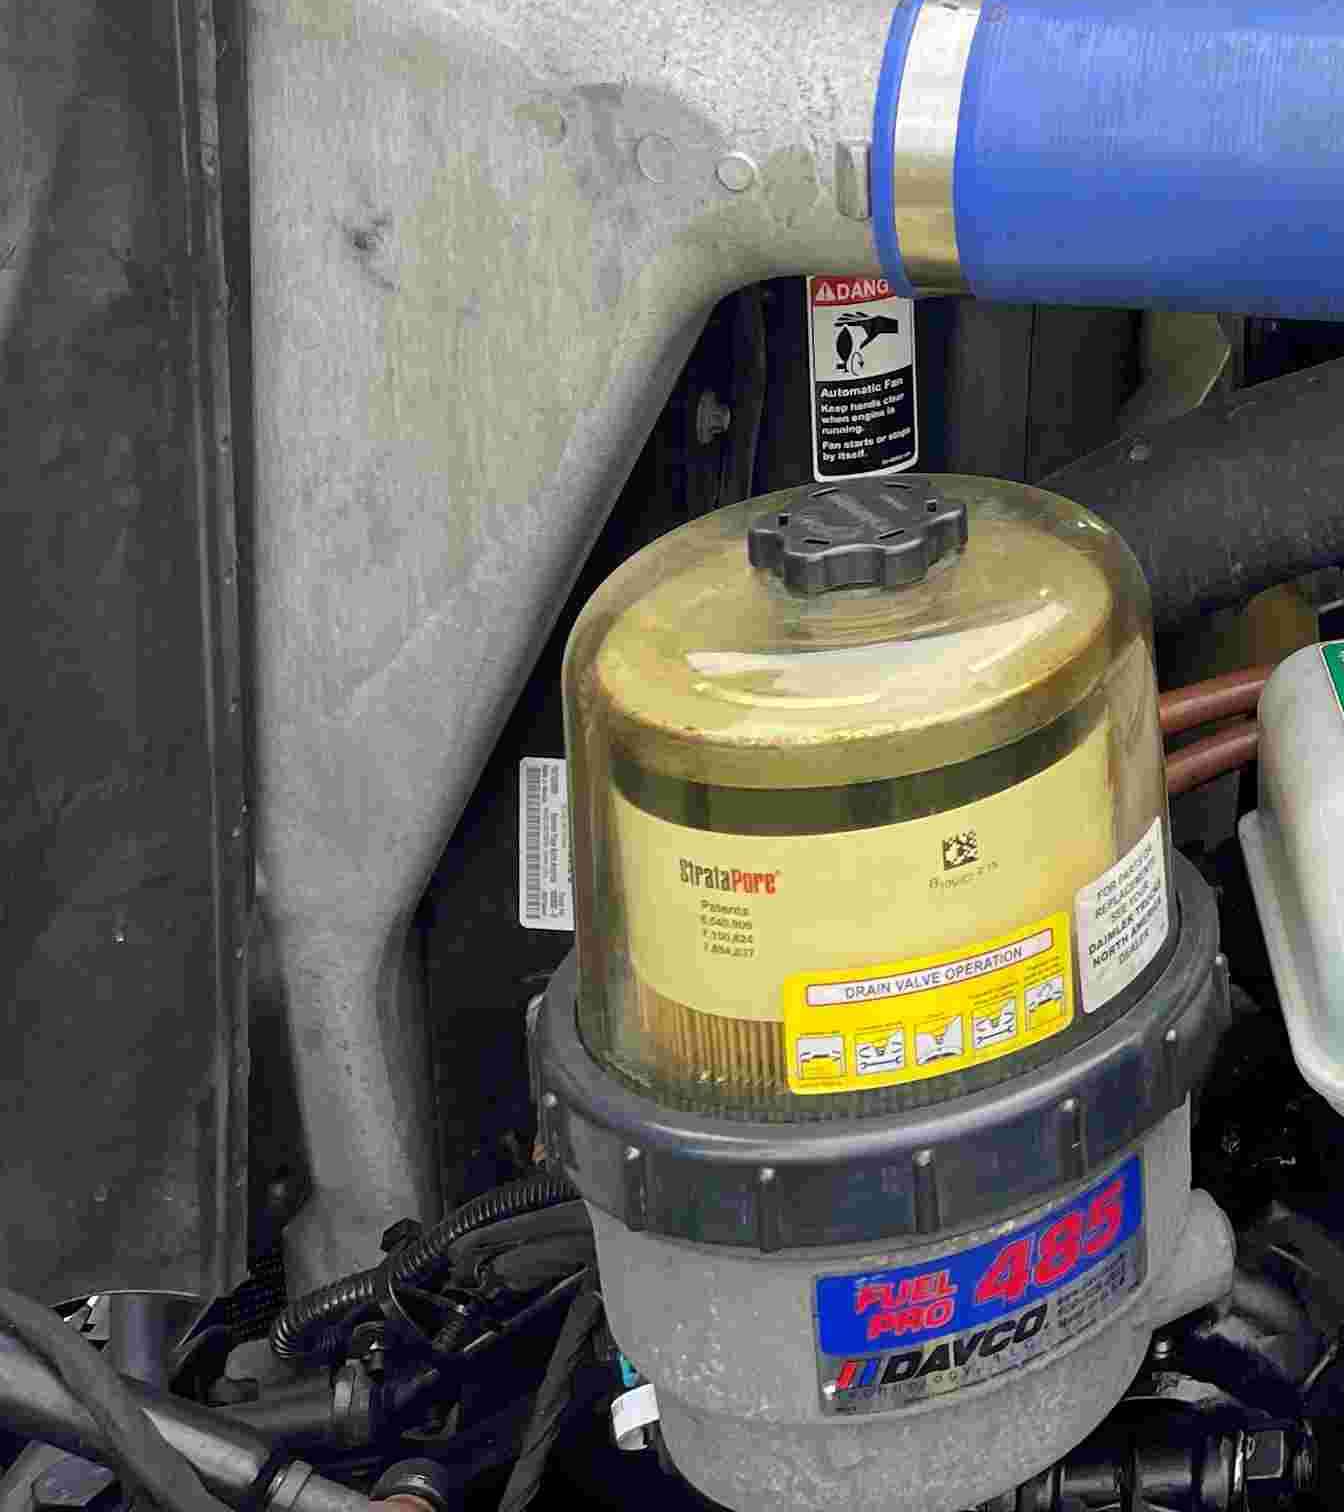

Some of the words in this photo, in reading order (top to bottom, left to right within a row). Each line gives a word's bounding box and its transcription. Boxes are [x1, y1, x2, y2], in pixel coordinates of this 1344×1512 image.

[837, 279, 890, 301] DANG
[820, 383, 882, 399] Automatic
[884, 377, 904, 390] Fan
[821, 402, 848, 415] Keep
[850, 399, 881, 411] hands
[821, 414, 850, 424] when
[851, 410, 885, 423] engine
[886, 406, 896, 416] is
[821, 424, 864, 436] running.
[822, 439, 841, 450] Fan
[844, 437, 874, 449] starts
[876, 435, 887, 444] or
[823, 452, 835, 462] by
[838, 449, 868, 461] itself.
[1097, 879, 1117, 900] FOR
[1089, 913, 1134, 955] DAIMLER
[1092, 935, 1129, 968] NORTH
[844, 982, 891, 1000] DRAIN
[896, 972, 940, 993] VALVE
[945, 946, 1023, 981] OPERATION
[975, 1176, 1124, 1307] 485
[855, 1269, 959, 1315] FUEL
[866, 1299, 954, 1341] PRO
[881, 1303, 1048, 1385] DAVCO
